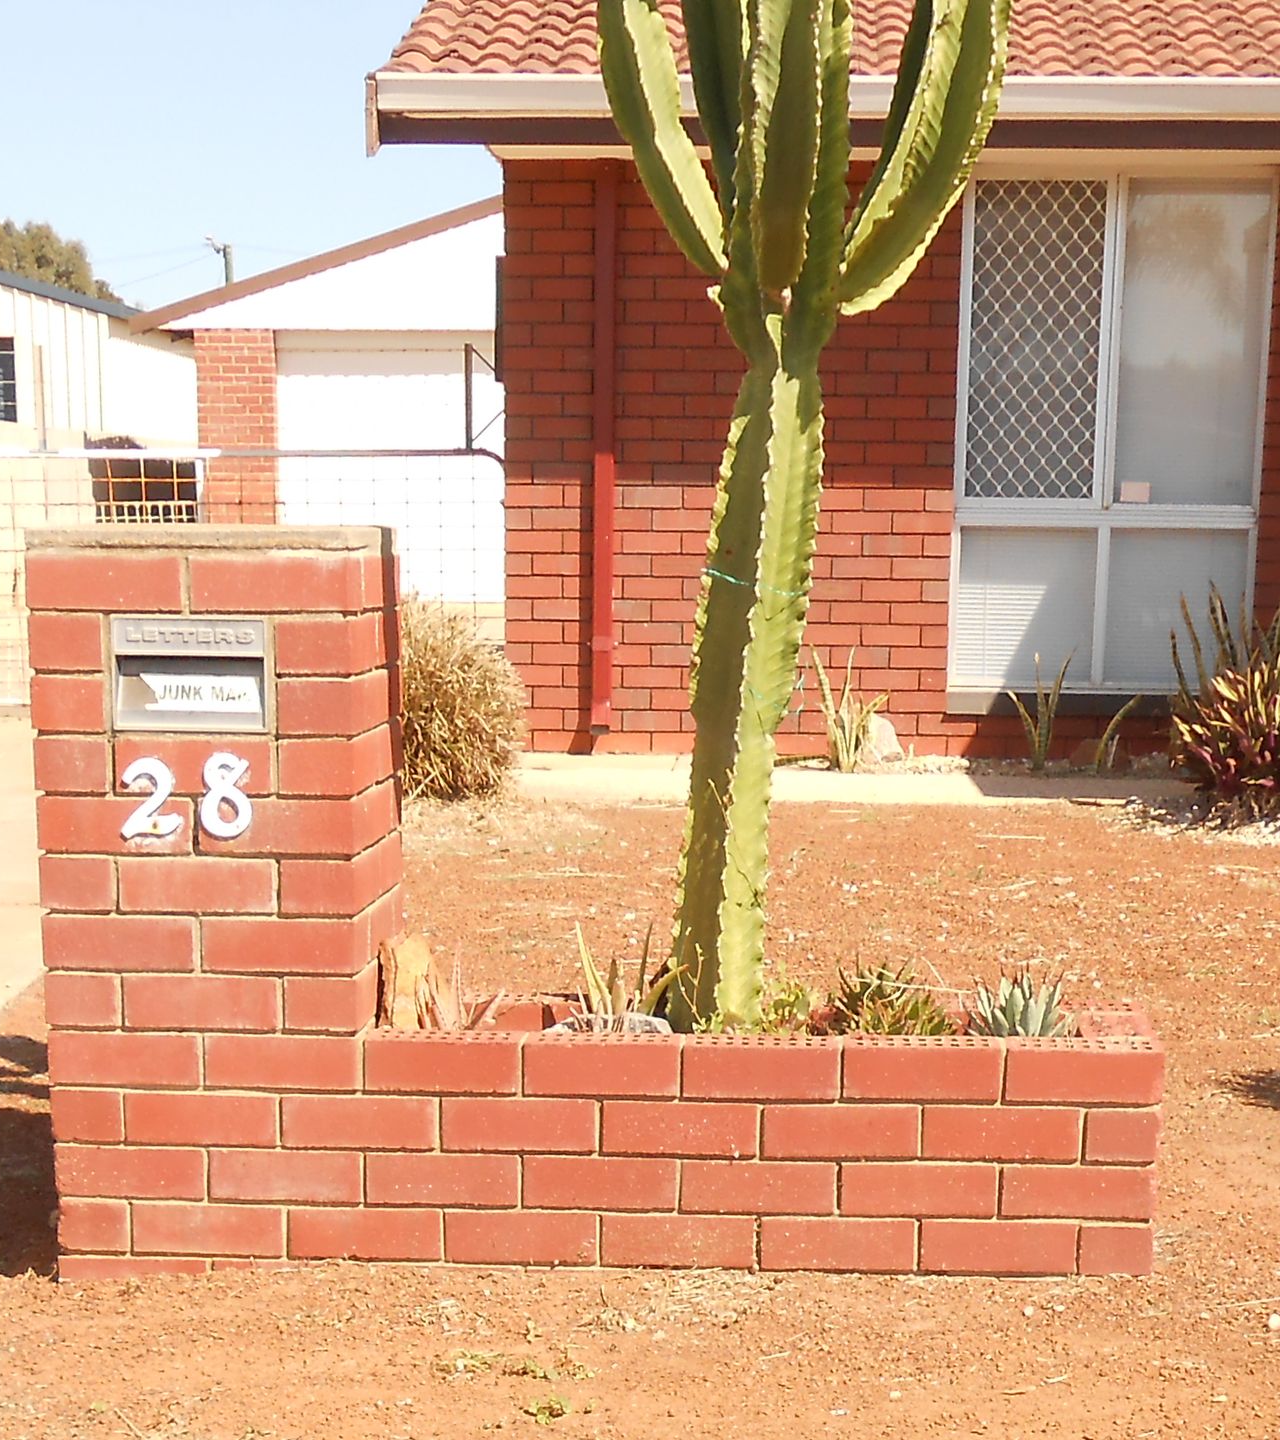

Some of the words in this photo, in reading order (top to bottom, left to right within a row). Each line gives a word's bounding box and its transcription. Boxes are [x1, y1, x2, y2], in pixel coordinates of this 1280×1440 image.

[125, 625, 256, 645] LETTERS
[159, 684, 203, 701] JUNK
[120, 752, 253, 841] 28
